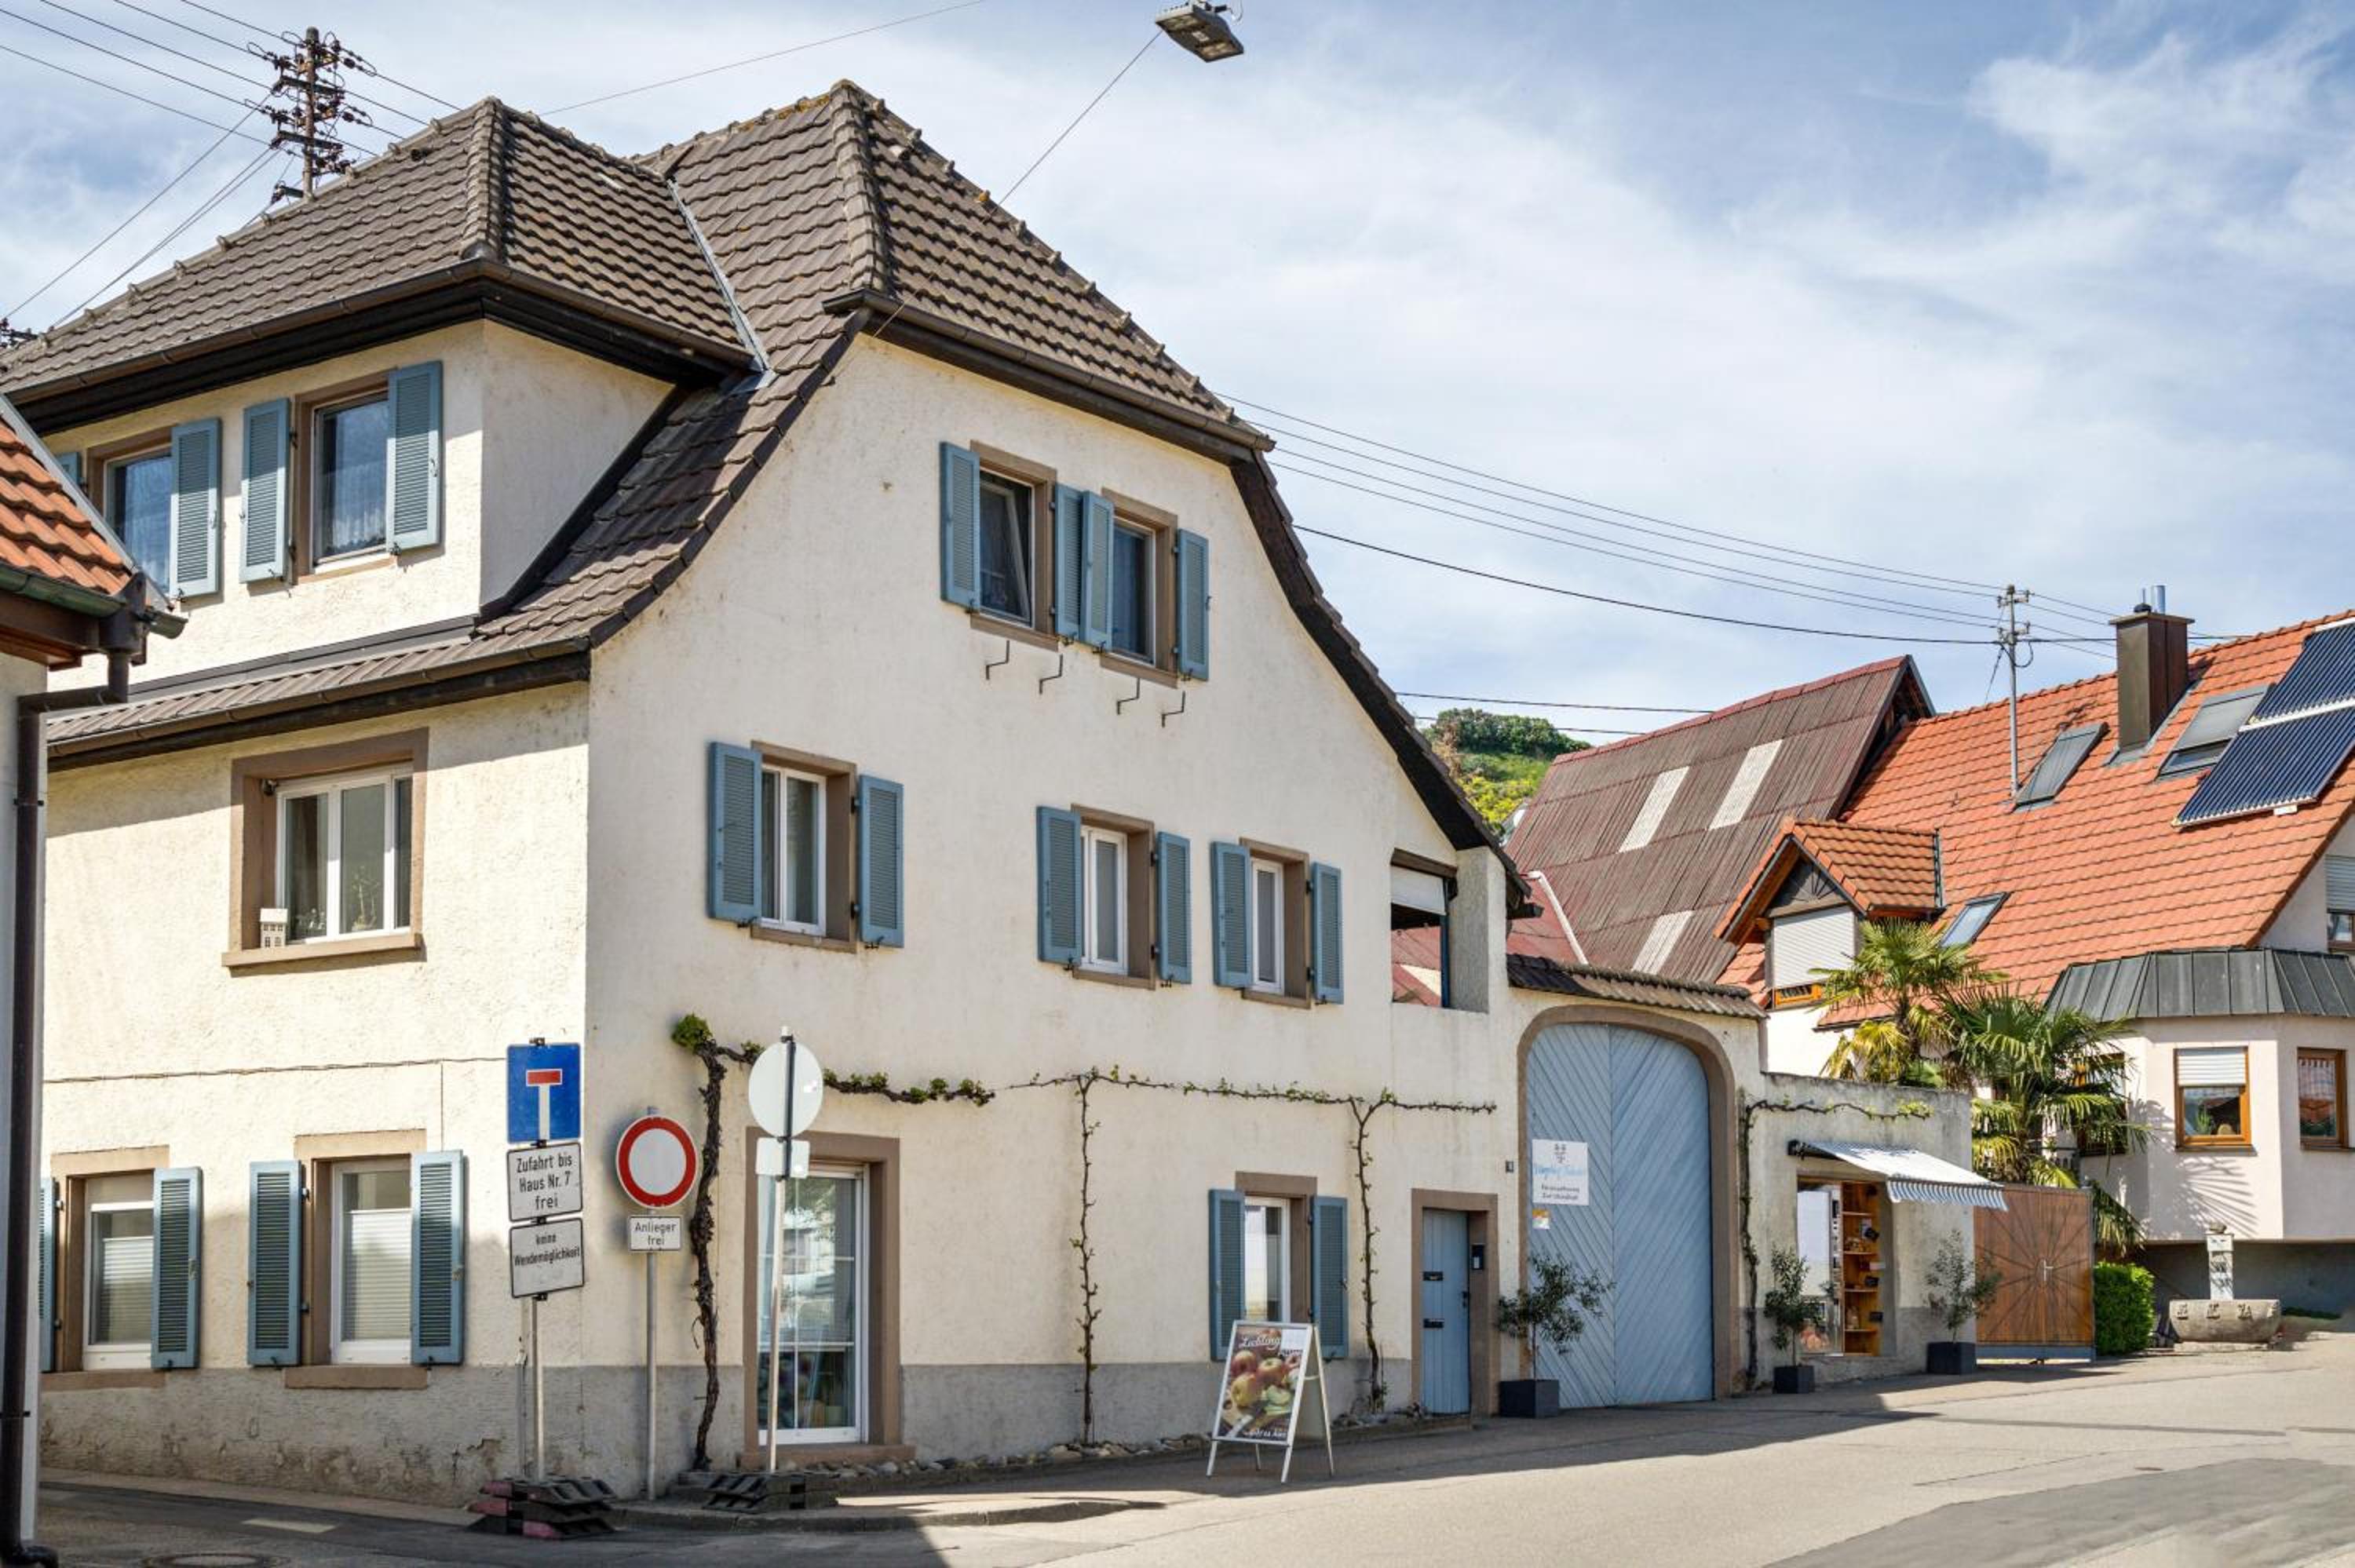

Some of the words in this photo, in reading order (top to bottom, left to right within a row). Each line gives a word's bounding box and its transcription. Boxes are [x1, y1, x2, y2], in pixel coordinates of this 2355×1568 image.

[517, 1155, 553, 1172] Zufahrt
[558, 1153, 572, 1167] bis
[519, 1176, 545, 1192] Haus
[548, 1174, 561, 1188] Nr.
[564, 1170, 571, 1185] 7
[535, 1192, 558, 1209] frei
[635, 1221, 676, 1234] Anlieger
[535, 1233, 557, 1245] keine
[648, 1234, 665, 1245] frei
[514, 1245, 580, 1266] Wendemöglichkeit
